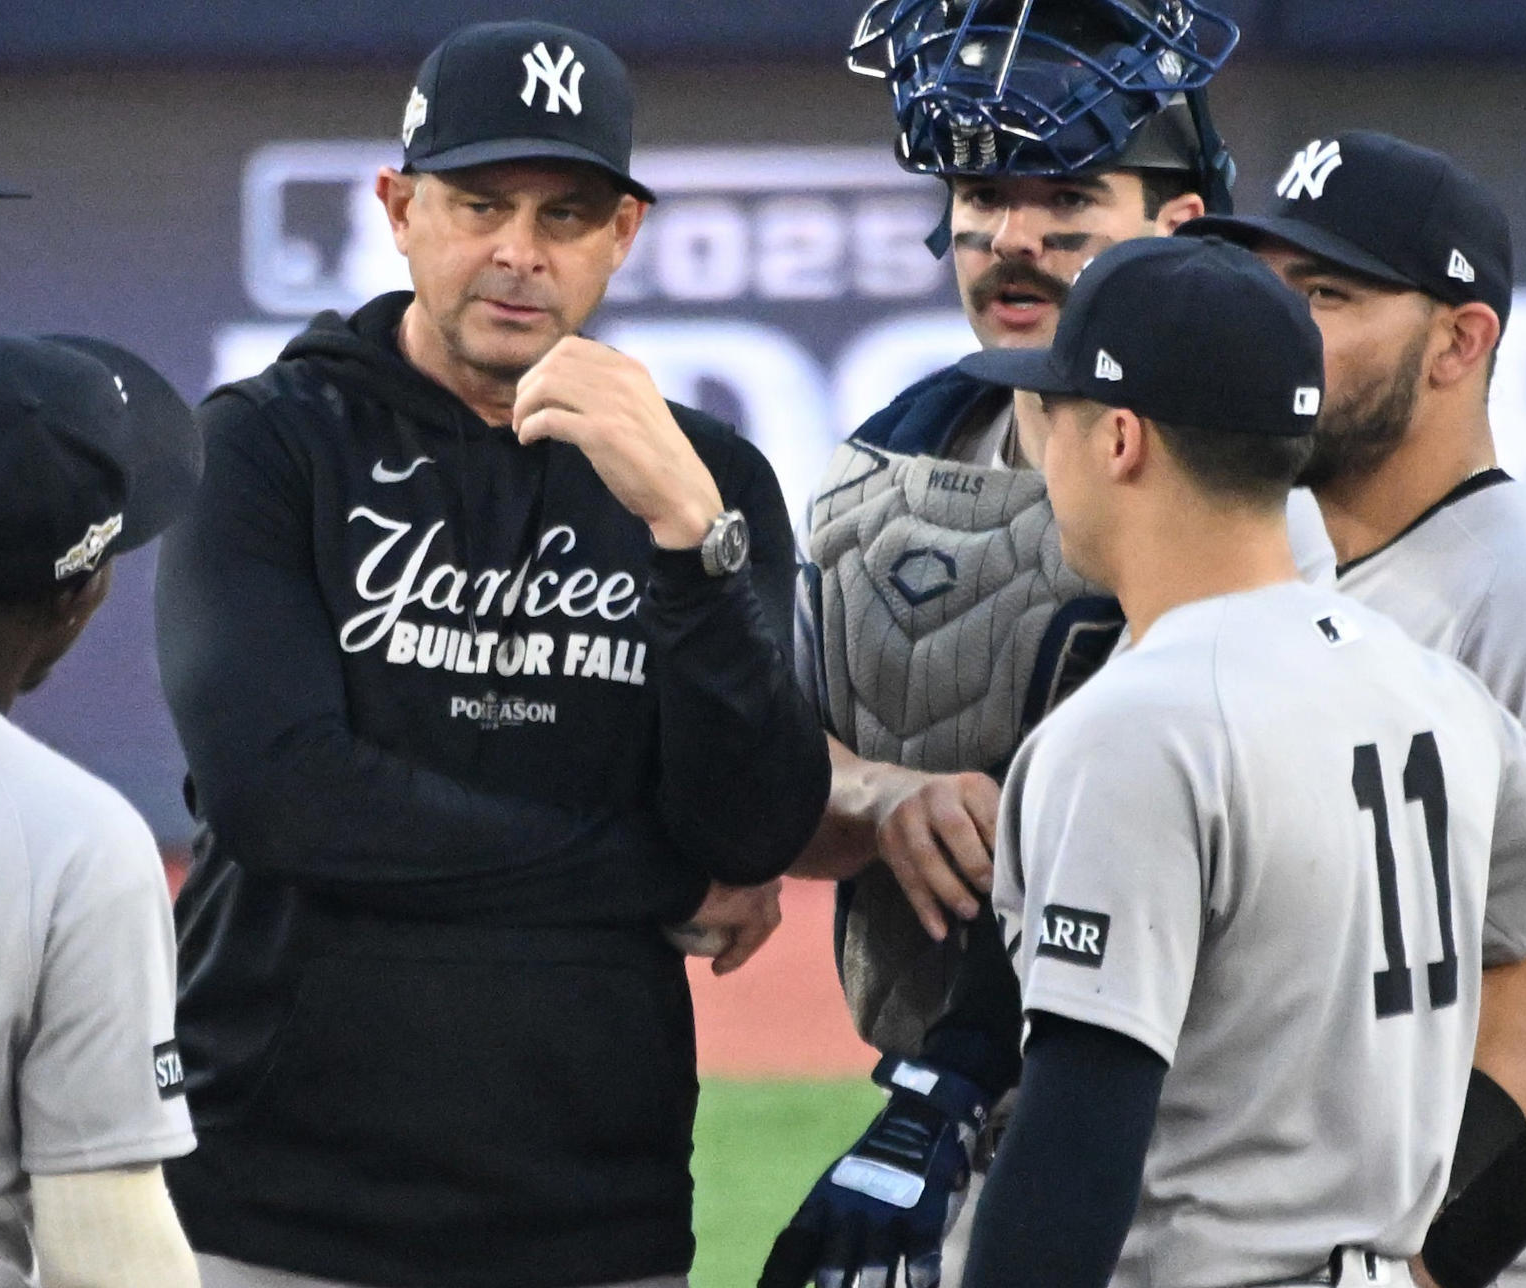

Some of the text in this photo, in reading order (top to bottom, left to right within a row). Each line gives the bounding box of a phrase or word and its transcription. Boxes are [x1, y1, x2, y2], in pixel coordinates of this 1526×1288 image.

[928, 469, 985, 494] WELLS
[340, 506, 643, 653] Yankee
[387, 621, 498, 674] BUILT
[563, 634, 647, 685] FALL
[1351, 730, 1459, 1019] 11
[1040, 916, 1102, 956] ARR
[156, 1052, 184, 1088] STA
